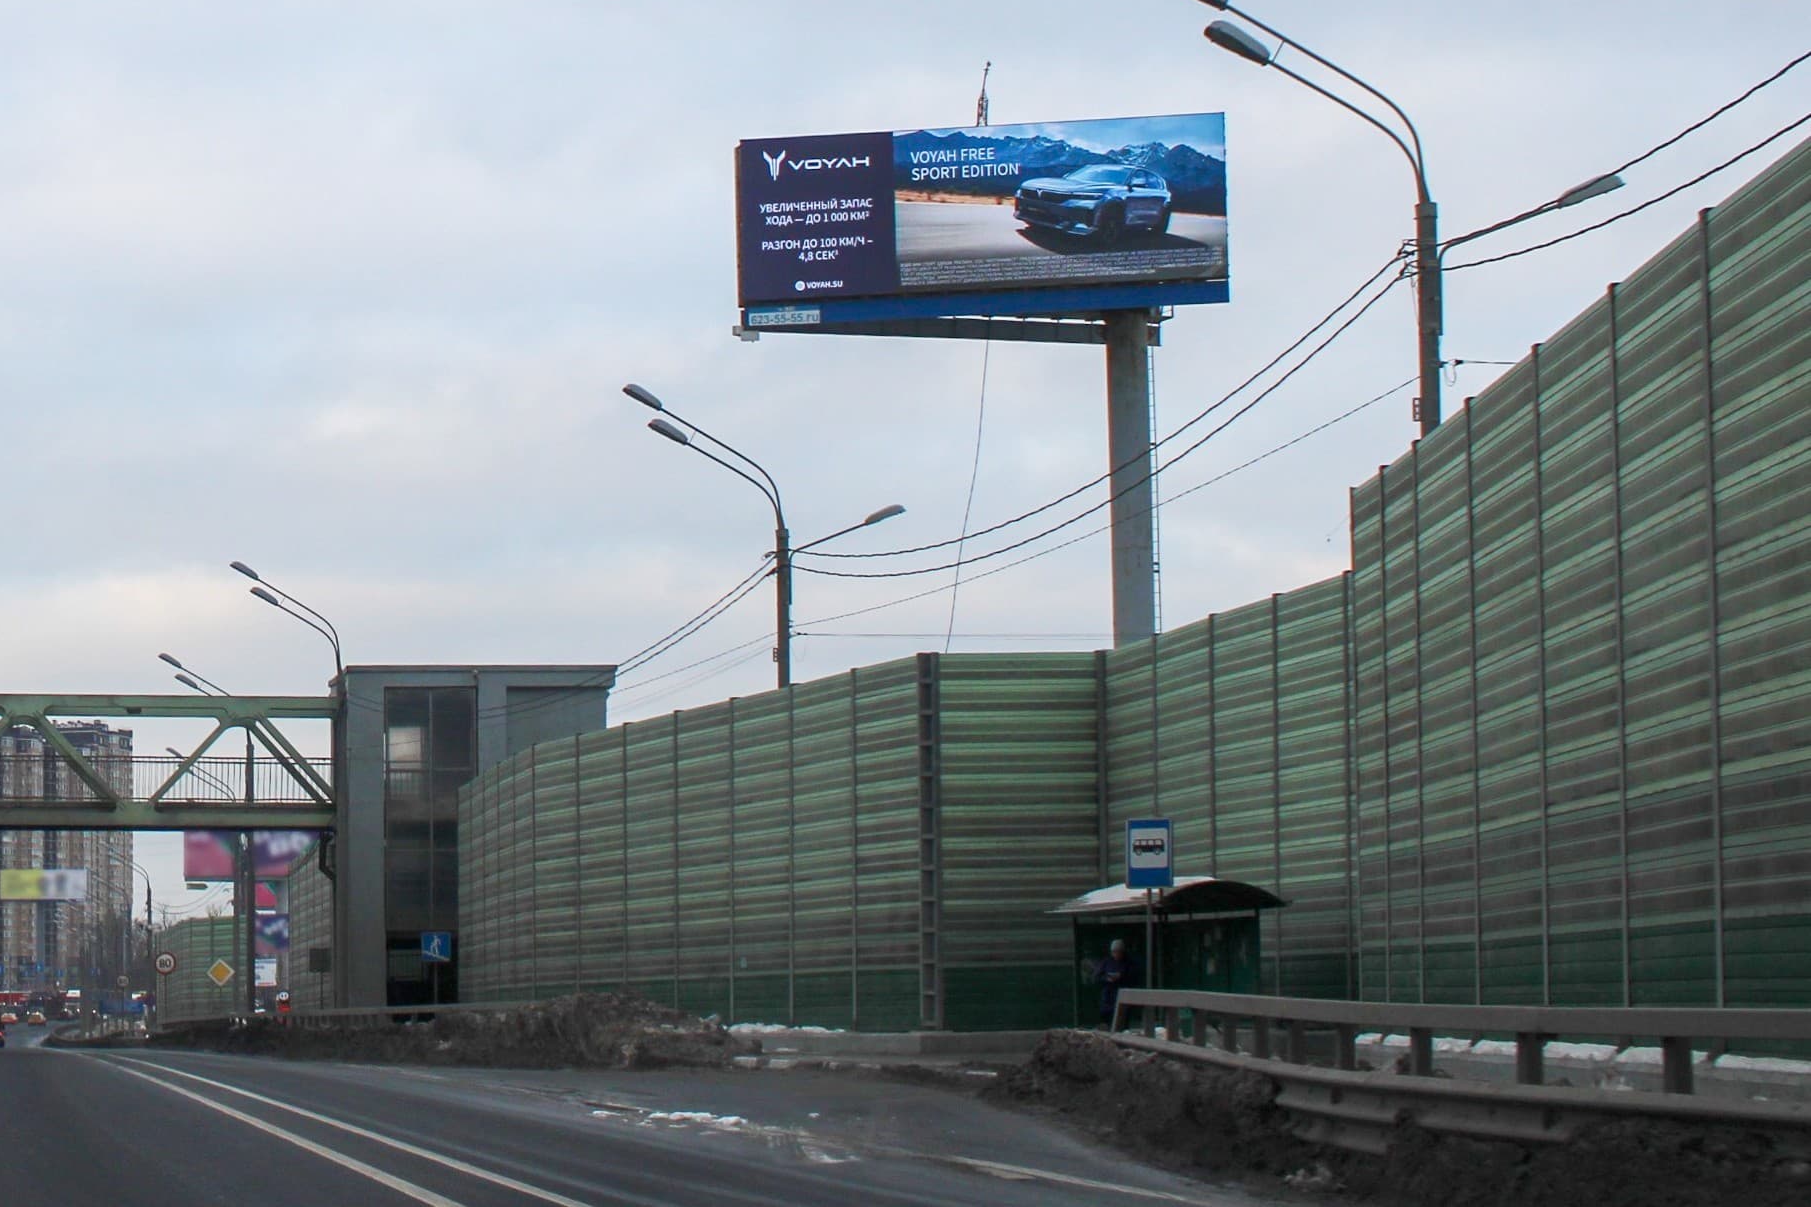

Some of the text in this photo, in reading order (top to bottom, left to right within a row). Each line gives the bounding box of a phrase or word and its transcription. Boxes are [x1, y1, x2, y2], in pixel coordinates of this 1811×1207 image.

[910, 147, 995, 164] VOYAH FREE
[788, 156, 870, 170] VOYAH
[911, 166, 958, 181] SPORT
[759, 198, 873, 213] УВЕЛИЧЕННЫЙ ЗАПАС
[765, 215, 793, 226] ХОДА
[805, 213, 821, 225] ДО
[823, 213, 829, 223] 1
[762, 240, 801, 250] РАЗГОН
[802, 239, 817, 250] ДО
[820, 237, 837, 248] 100
[839, 236, 865, 247] КМ/Ч
[806, 280, 844, 289] VOYAH.SU
